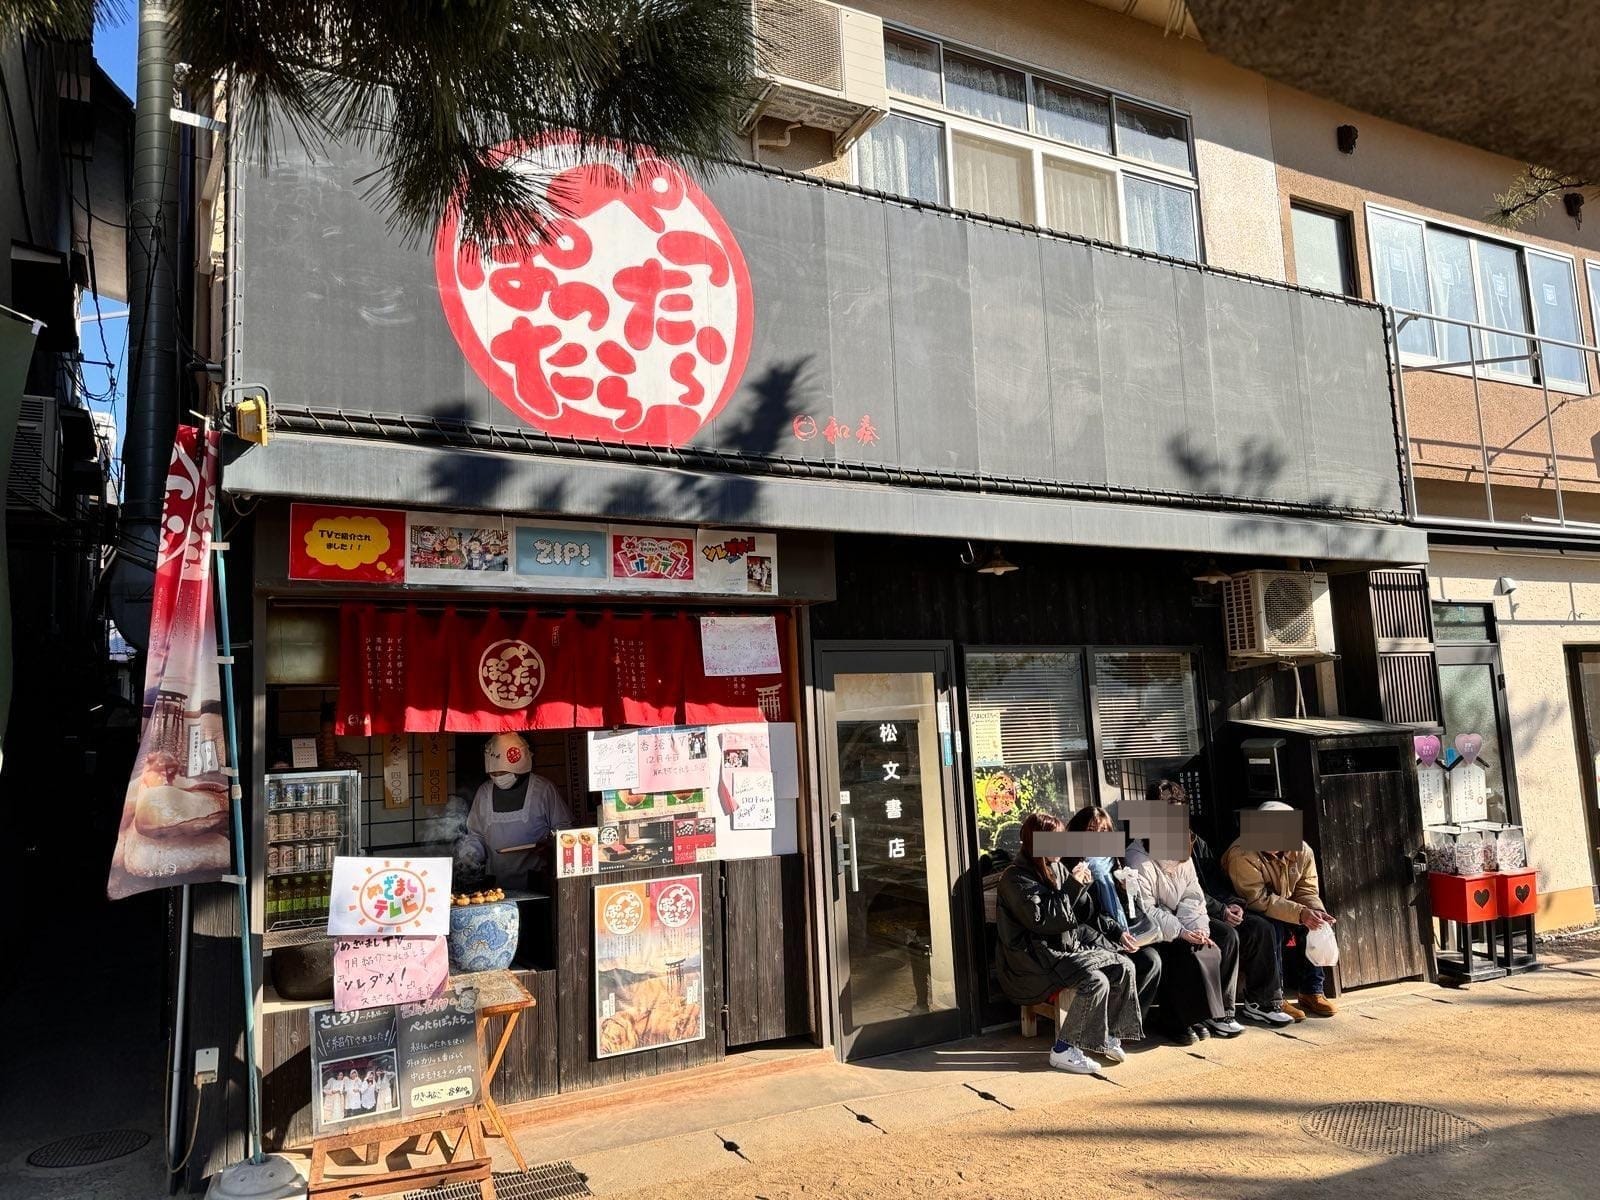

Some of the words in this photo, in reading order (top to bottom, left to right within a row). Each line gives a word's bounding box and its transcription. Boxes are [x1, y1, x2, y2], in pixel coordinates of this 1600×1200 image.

[318, 529, 372, 542] TVで紹介され
[533, 538, 590, 567] ZIP!
[879, 723, 906, 859] 松文書店
[367, 874, 418, 901] めざまし
[374, 893, 419, 918] テレビ
